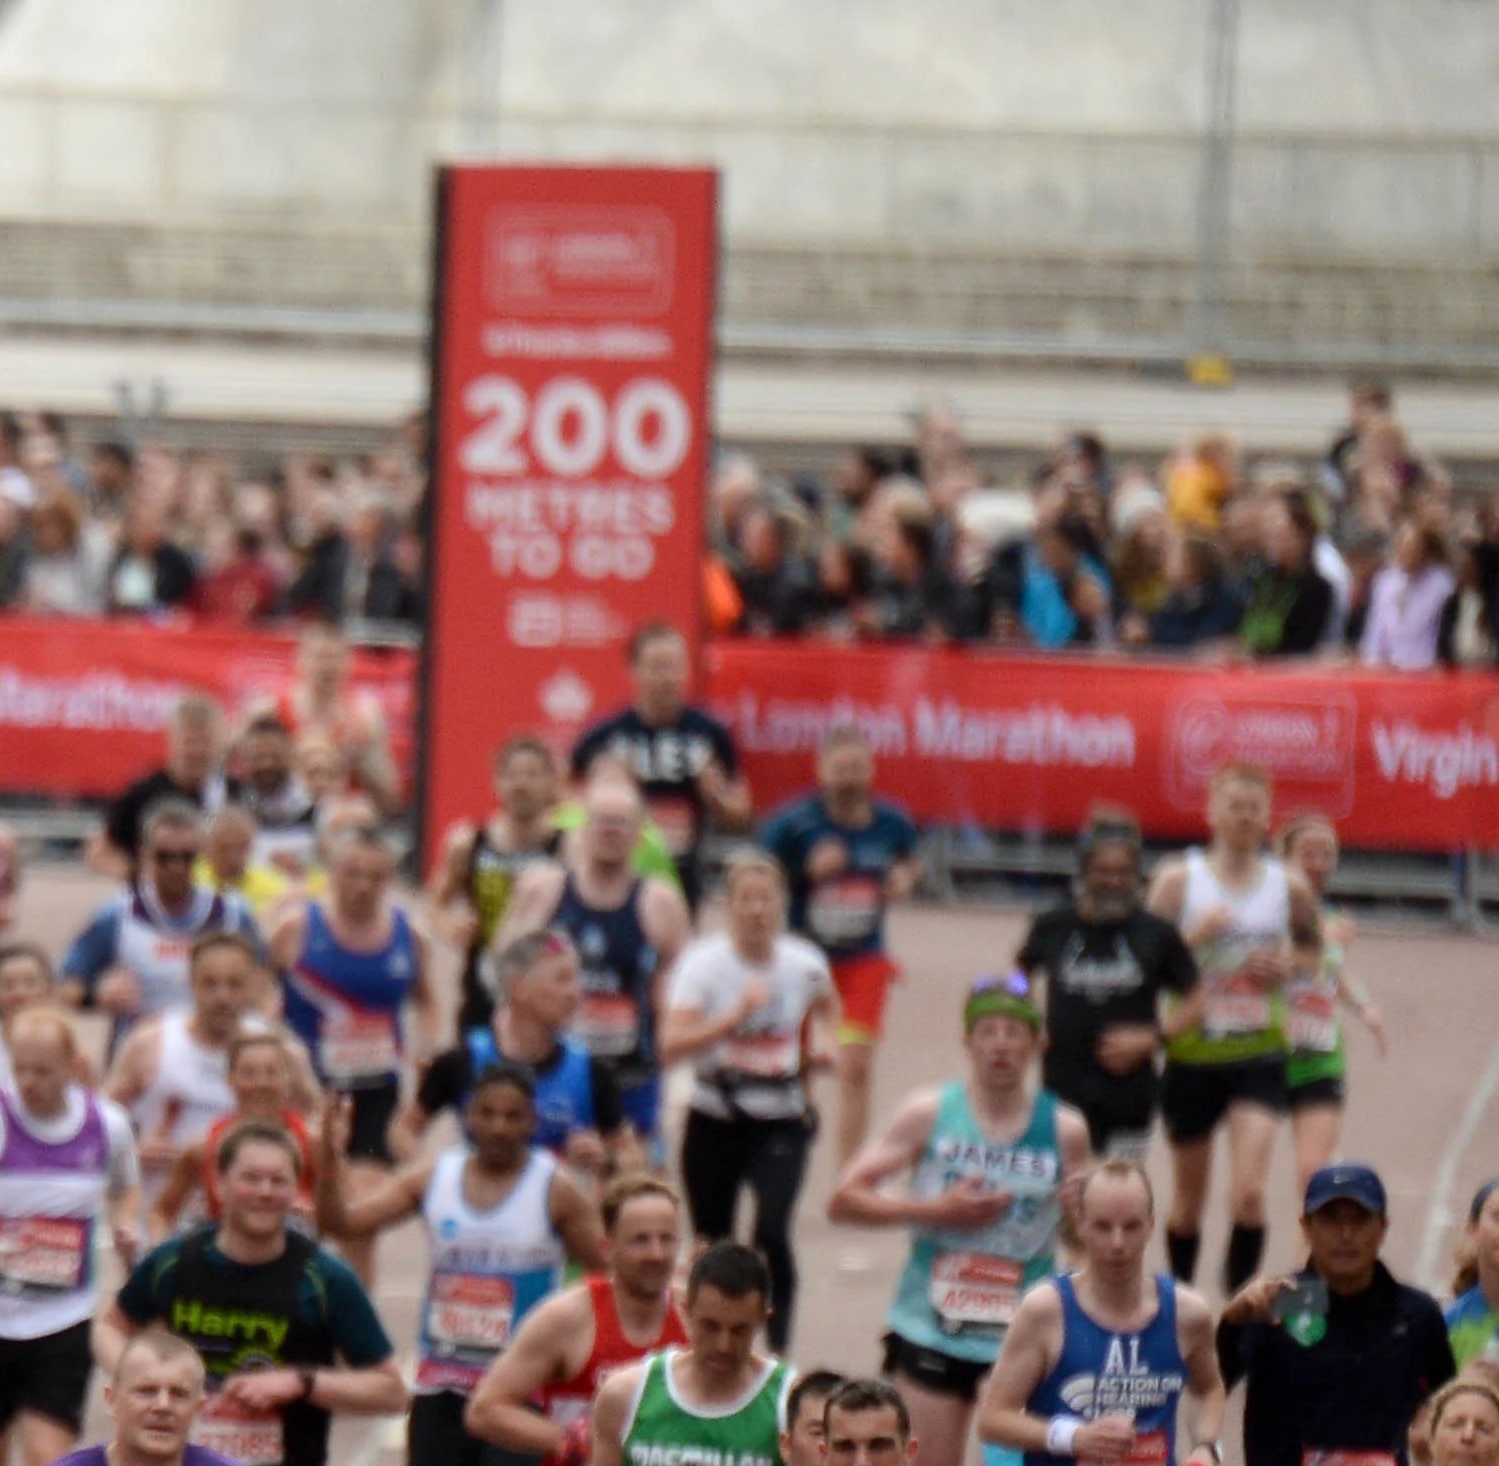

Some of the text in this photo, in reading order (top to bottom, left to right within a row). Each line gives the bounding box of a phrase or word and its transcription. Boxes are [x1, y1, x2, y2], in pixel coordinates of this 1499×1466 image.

[460, 374, 692, 479] 200
[464, 481, 675, 534] METRES
[488, 531, 656, 581] TO GO
[741, 690, 907, 757] London
[915, 699, 1135, 767] Marathon
[1373, 719, 1499, 798] Virgin
[173, 1299, 289, 1349] Harry
[1105, 1336, 1148, 1376] AL
[1099, 1376, 1159, 1391] ACTION
